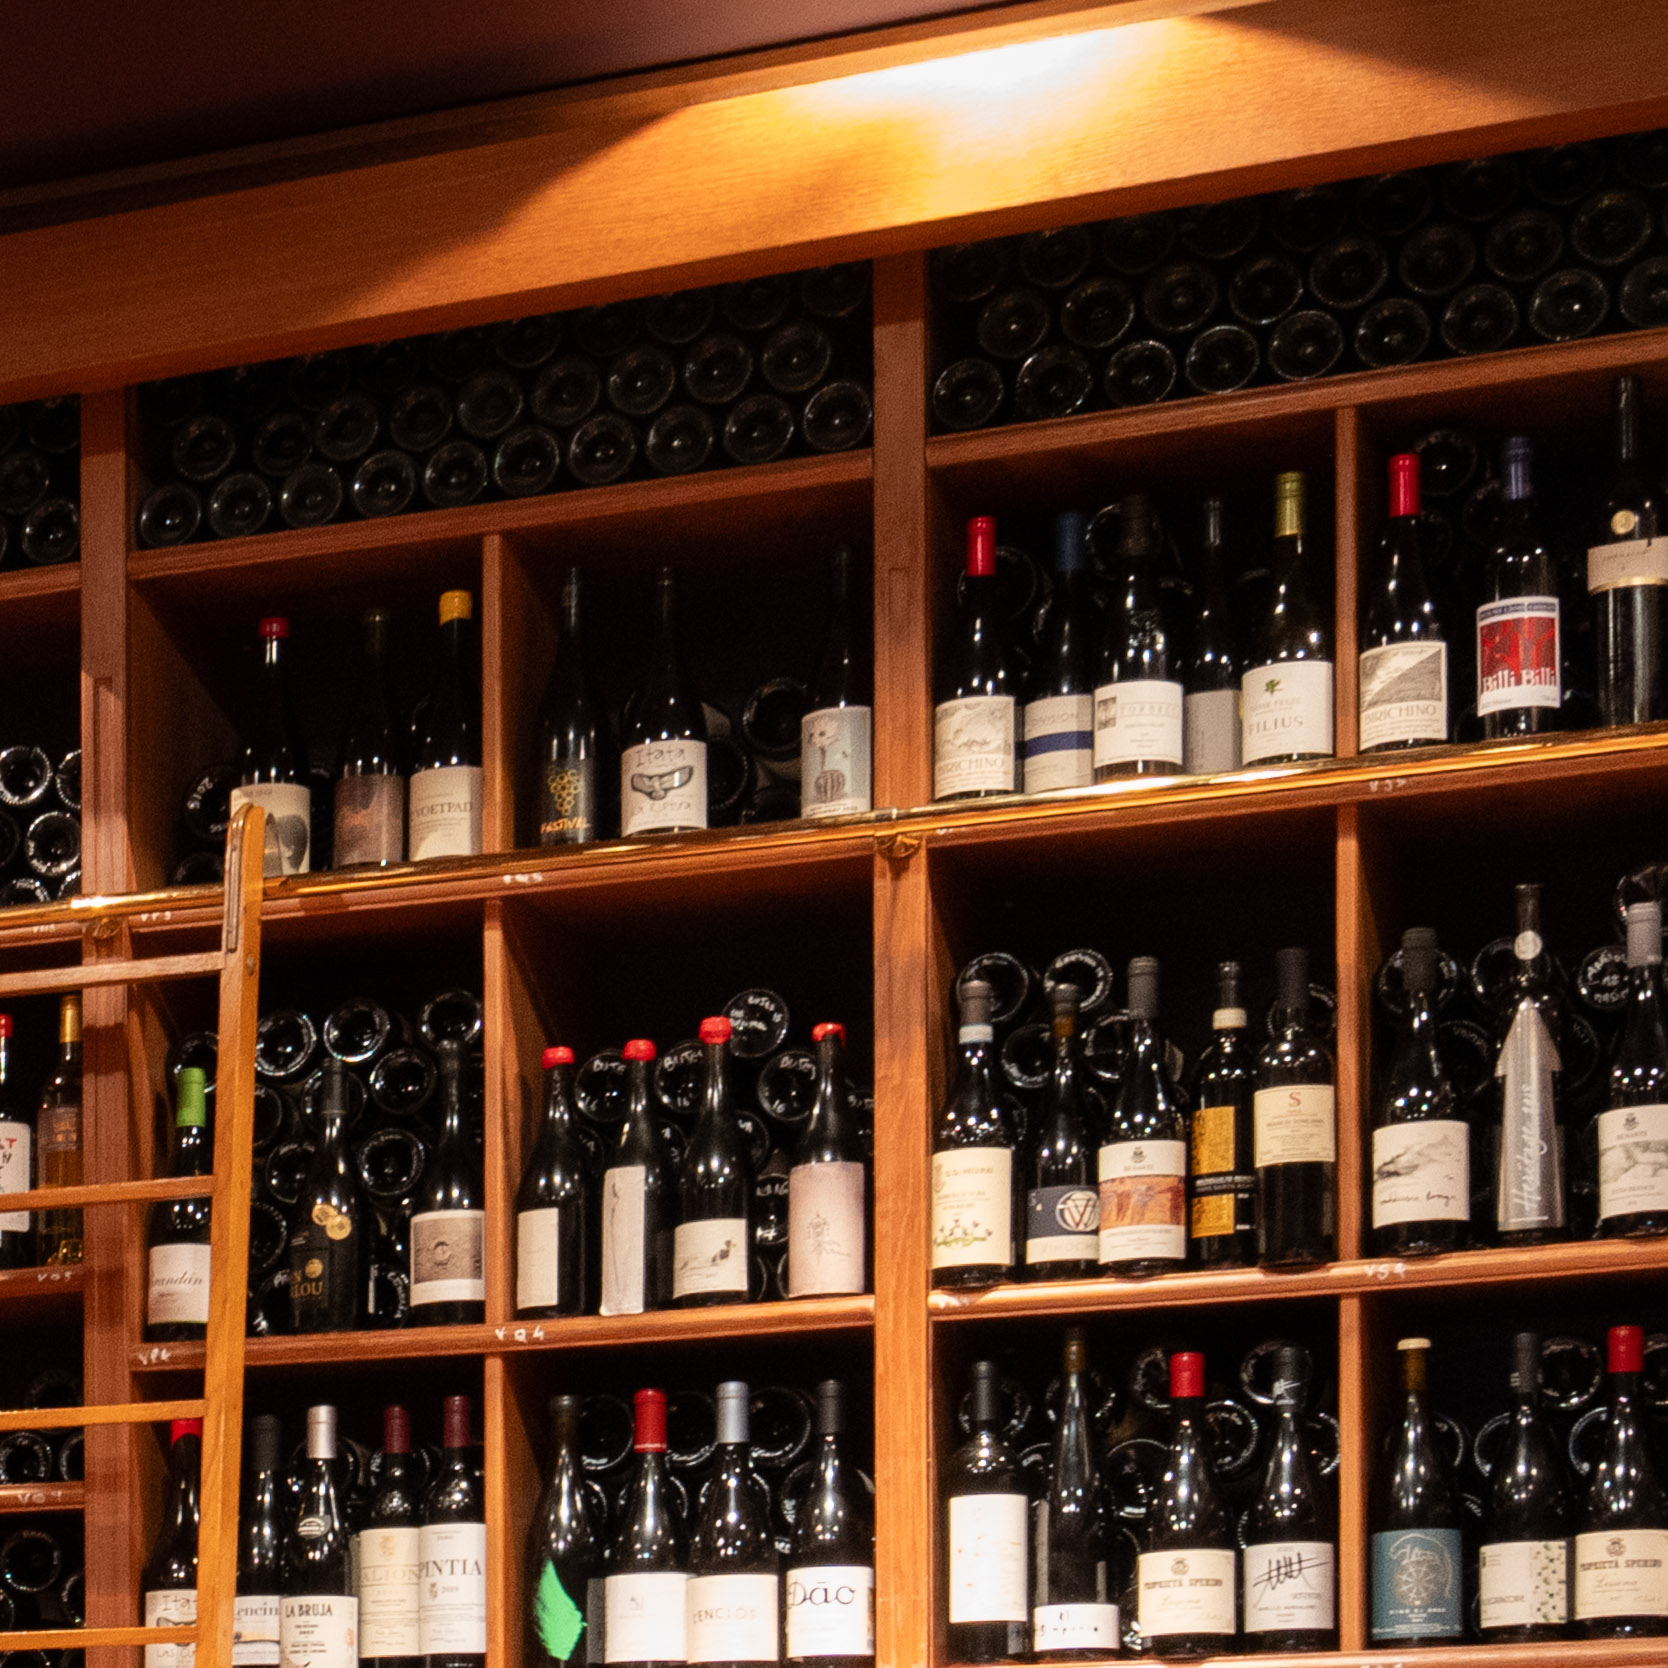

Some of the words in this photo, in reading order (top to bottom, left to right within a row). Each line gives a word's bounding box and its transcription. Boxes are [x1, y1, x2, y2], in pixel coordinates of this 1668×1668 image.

[1481, 675, 1515, 695] Billi
[1520, 668, 1557, 689] Billi
[418, 1556, 484, 1579] PINTIA
[787, 1579, 857, 1611] Dão
[284, 1603, 300, 1622] LA
[301, 1601, 343, 1620] BRUJA
